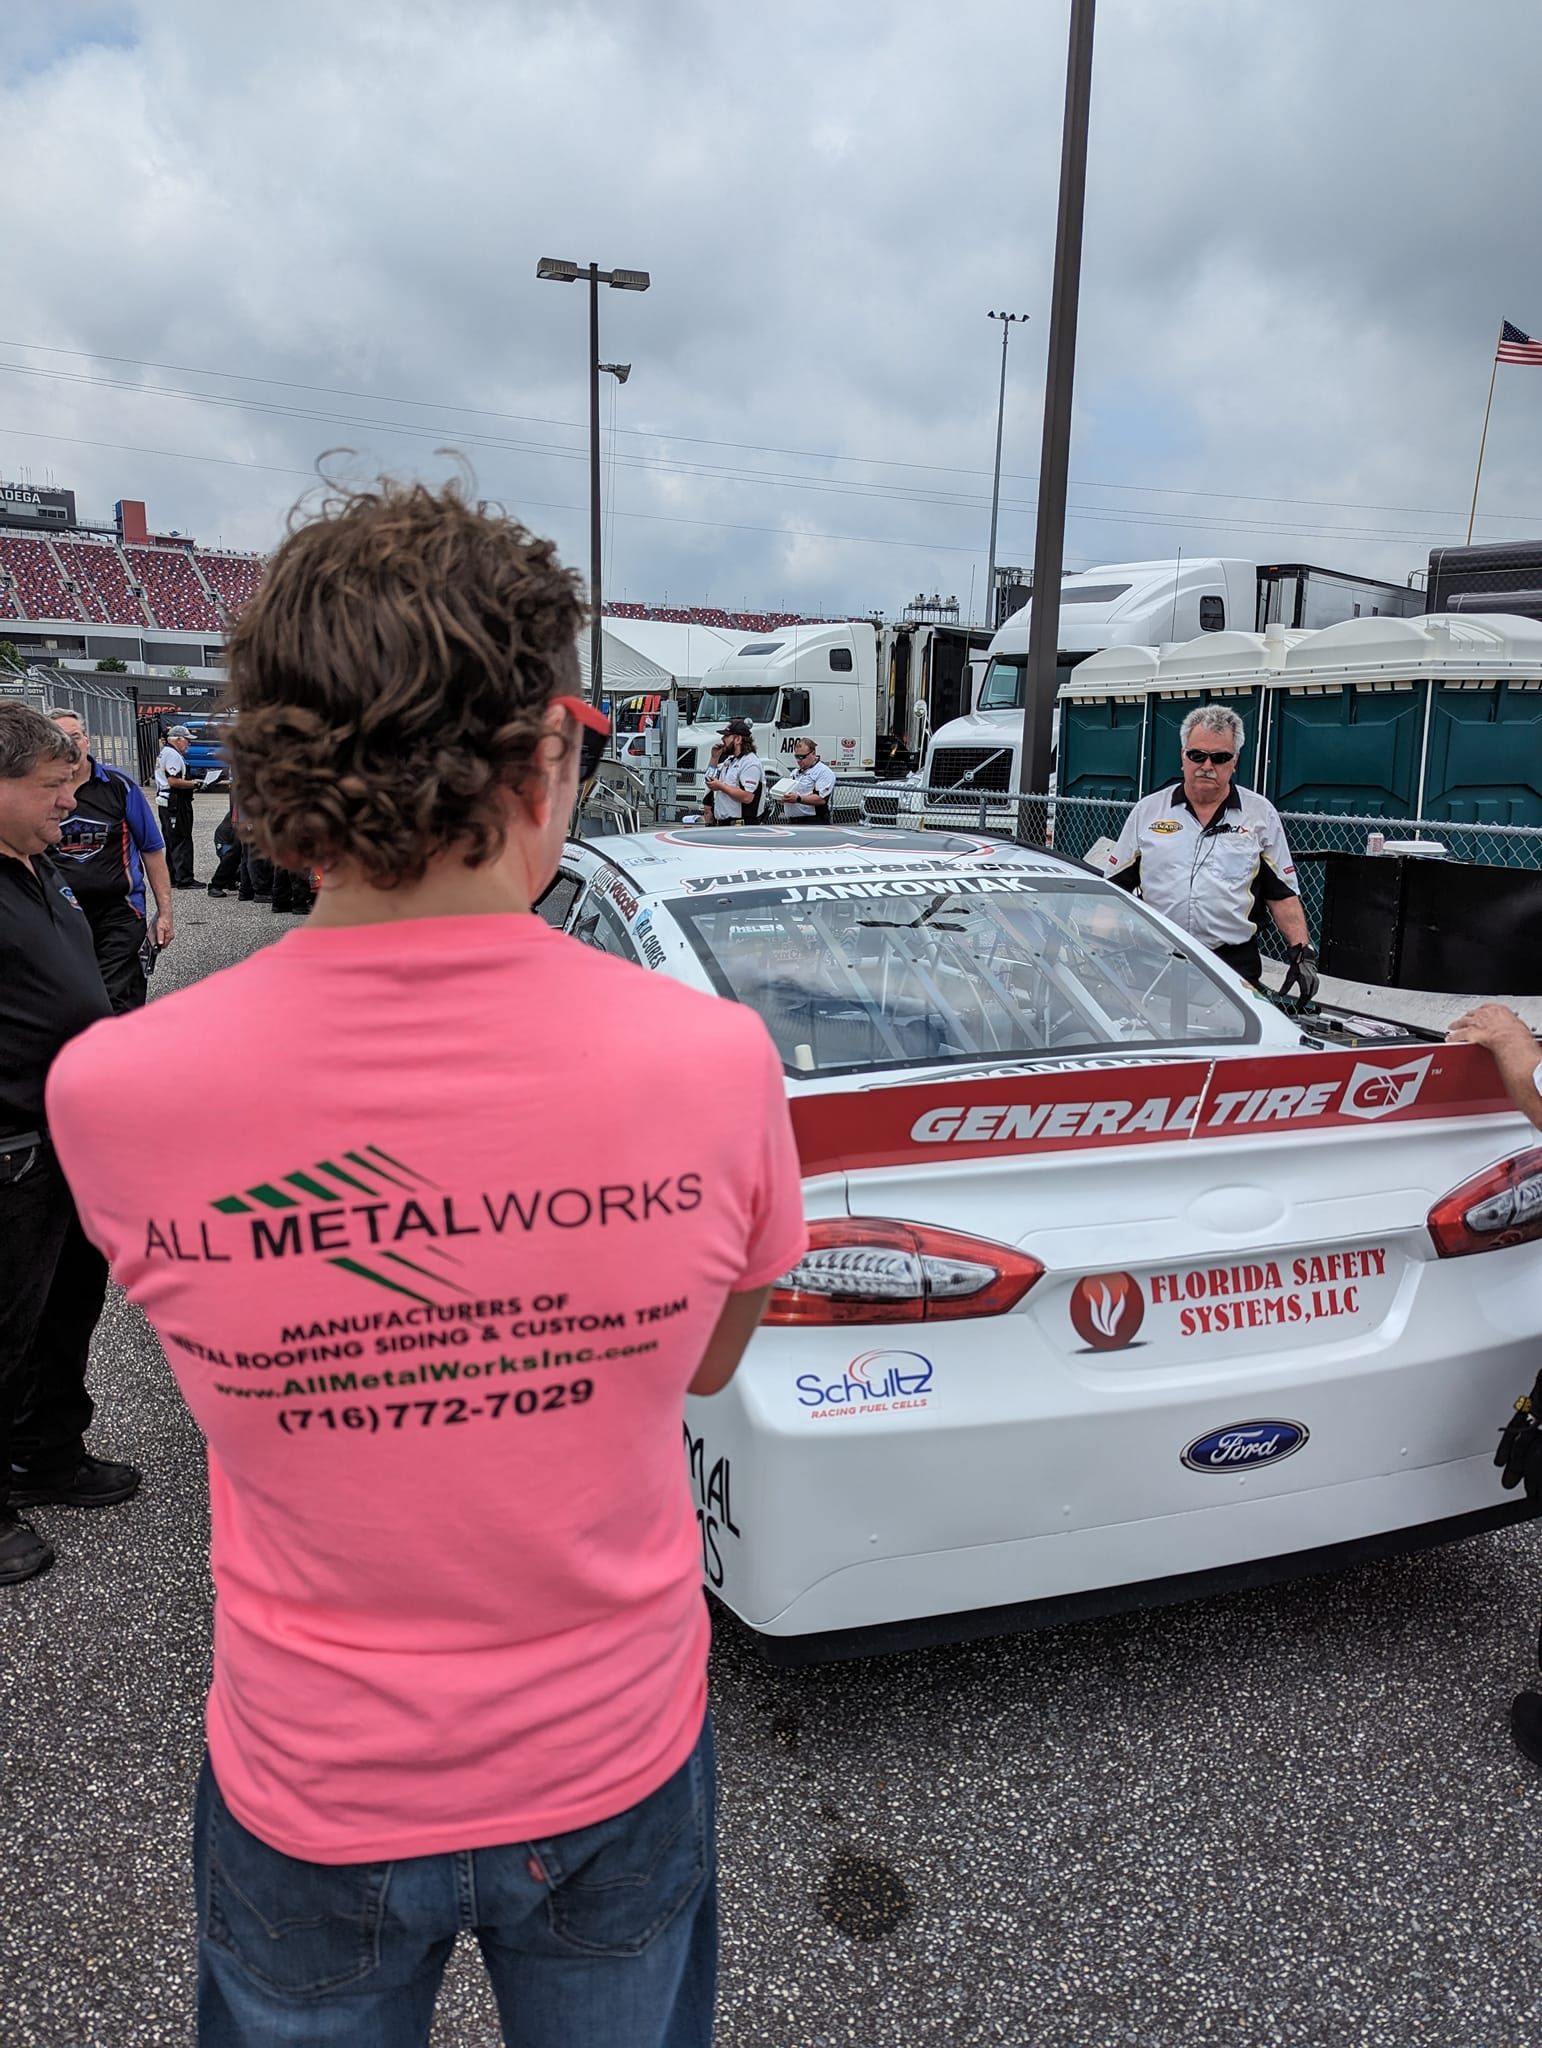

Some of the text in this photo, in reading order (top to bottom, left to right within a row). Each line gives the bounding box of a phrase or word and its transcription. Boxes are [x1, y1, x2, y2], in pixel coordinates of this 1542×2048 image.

[683, 860, 1068, 893] yukoncreek.com
[781, 877, 1038, 904] JANKOWIAK
[642, 935, 667, 970] CORES
[910, 1095, 1201, 1143] GENERAL
[1206, 1081, 1342, 1127] TIRE
[144, 1219, 230, 1262] ALL
[1150, 1248, 1386, 1304] FLORIDA SAFETY
[236, 1340, 365, 1370] ROOFING
[375, 1328, 470, 1355] SIDING
[482, 1324, 499, 1342] &
[511, 1313, 626, 1338] CUSTOM
[635, 1296, 689, 1325] TRIM
[280, 1293, 569, 1344] MANUFACTURERS OF
[213, 1339, 659, 1399] www.AllMetalWorksInc.com
[796, 1366, 933, 1406] Schultz
[278, 1377, 594, 1434] (716)772-7029
[811, 1398, 928, 1420] RACING FUEL CELLS
[1210, 1429, 1280, 1464] Ford
